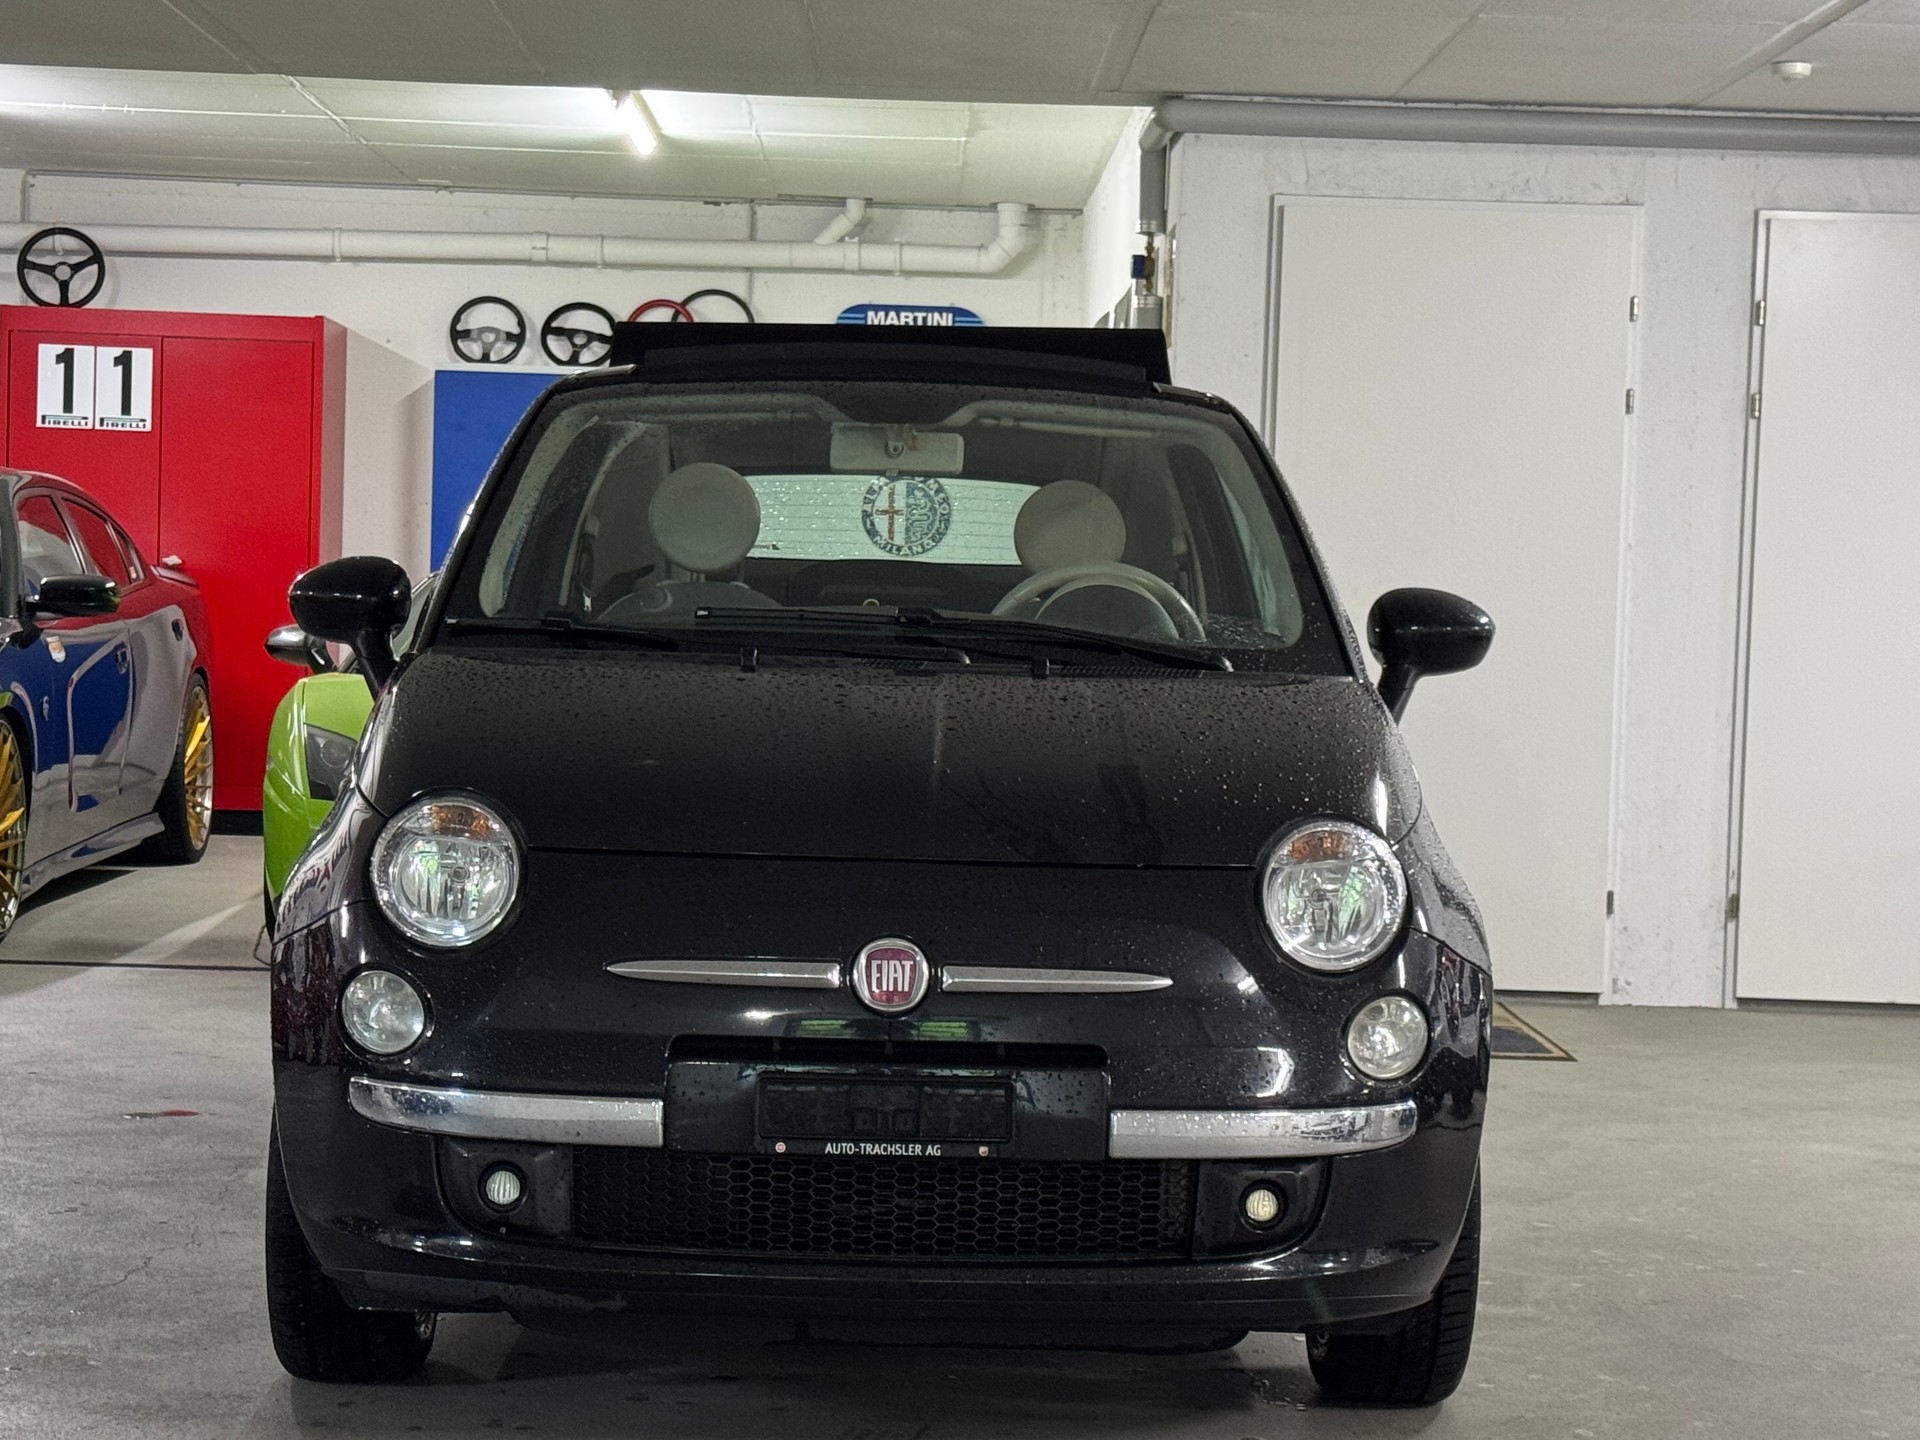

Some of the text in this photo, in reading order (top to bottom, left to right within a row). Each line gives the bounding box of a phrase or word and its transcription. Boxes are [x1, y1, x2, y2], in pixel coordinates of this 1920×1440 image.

[866, 310, 954, 327] MARTINI
[41, 414, 89, 427] PIRELLI
[99, 416, 147, 430] PIRELLI
[872, 535, 937, 556] MILANO
[871, 959, 914, 993] FIAT
[824, 1142, 942, 1157] AUTO-TRACHSLER AG
